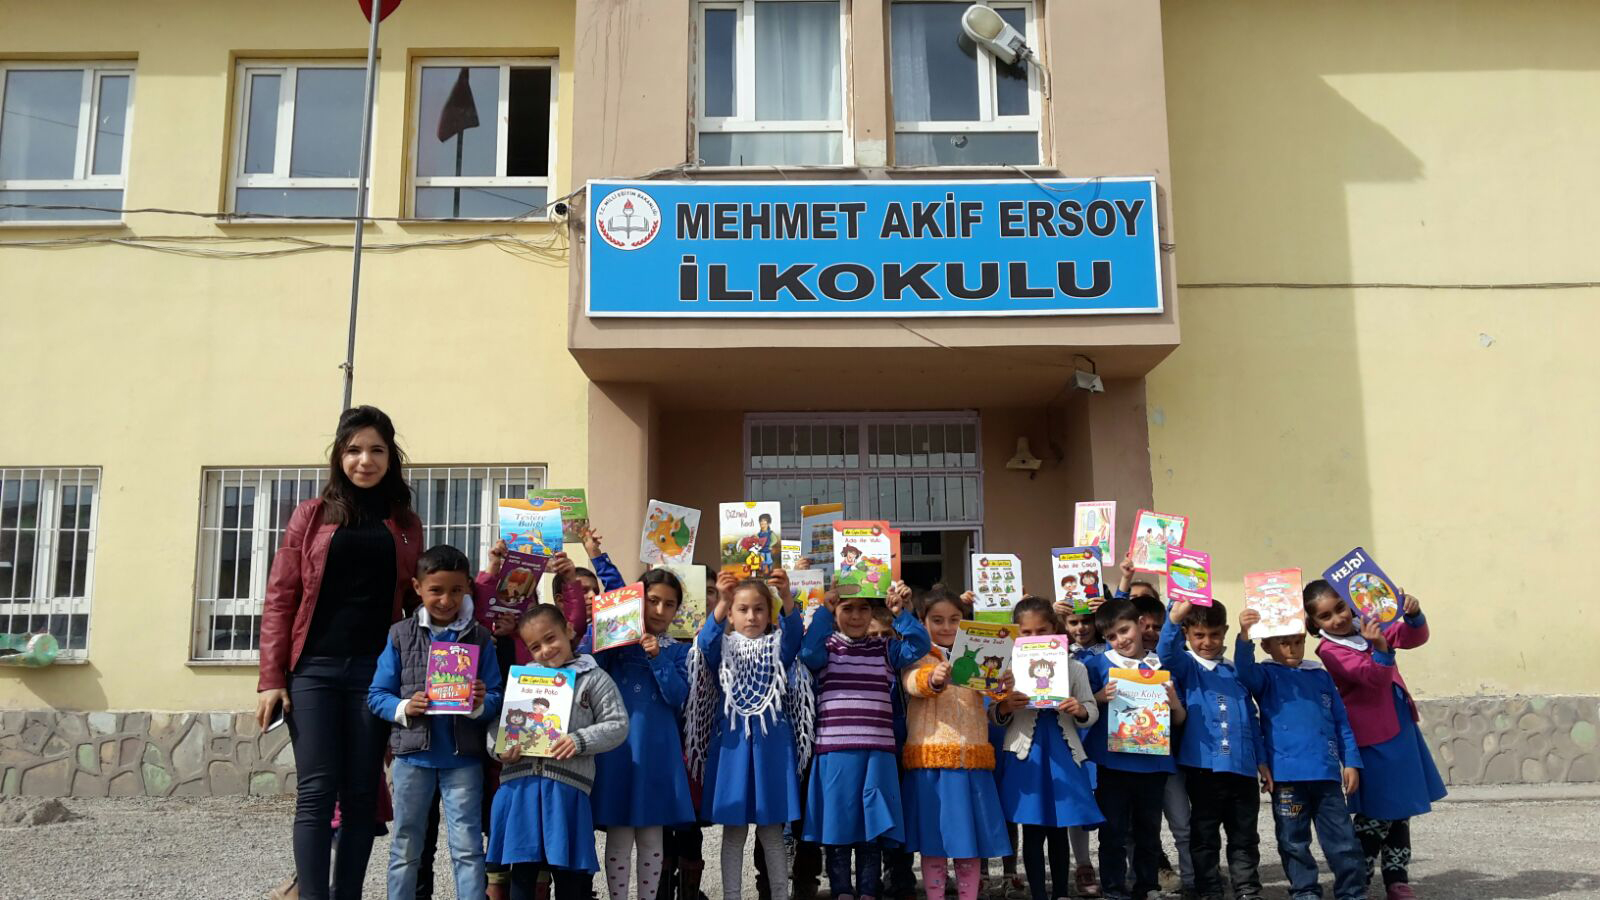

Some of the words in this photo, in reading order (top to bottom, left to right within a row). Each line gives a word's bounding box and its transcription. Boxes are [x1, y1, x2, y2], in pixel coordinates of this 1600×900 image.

[676, 202, 867, 239] MEHMET
[880, 192, 985, 239] AKİF
[999, 199, 1145, 238] ERSOY
[678, 254, 1112, 302] İLKOKULU
